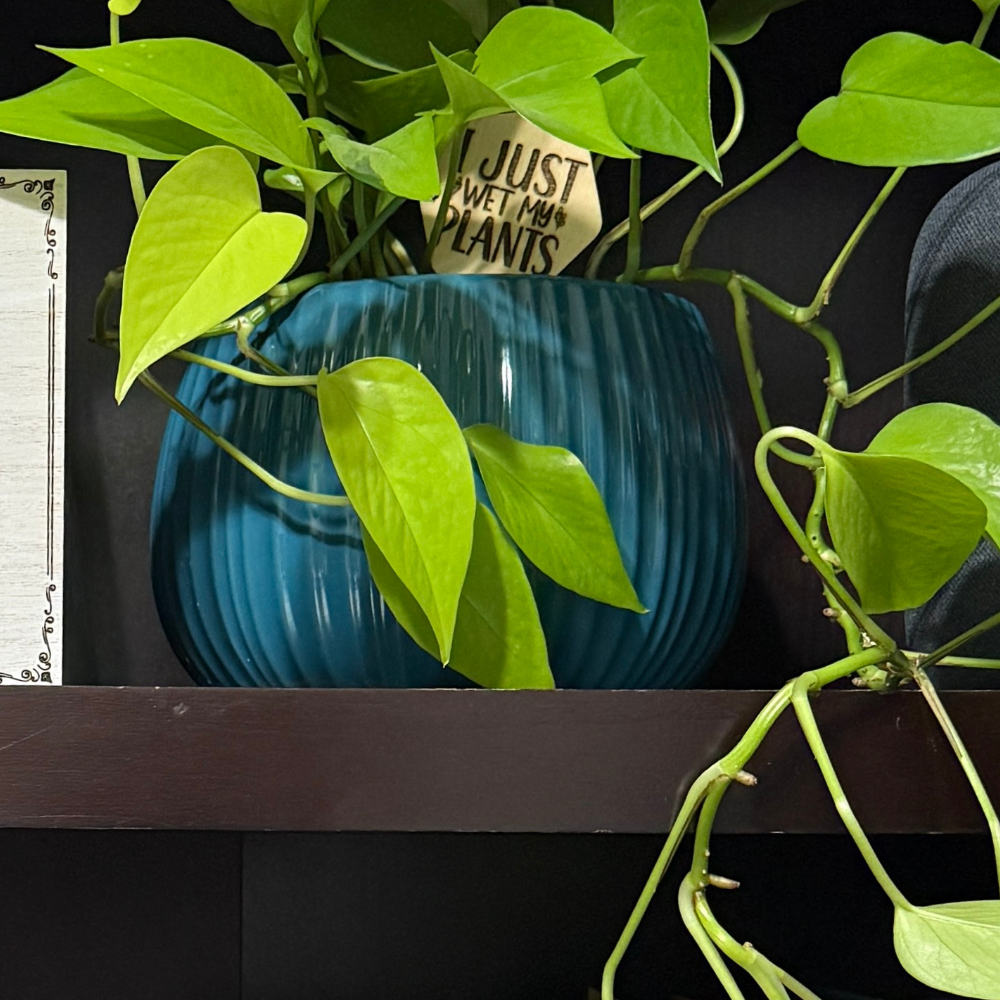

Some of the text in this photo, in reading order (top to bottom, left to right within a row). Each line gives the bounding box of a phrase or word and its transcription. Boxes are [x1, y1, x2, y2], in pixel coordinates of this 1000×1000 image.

[457, 129, 588, 203] I JUST
[462, 178, 556, 228] WET MY
[437, 205, 560, 275] PLANTS
